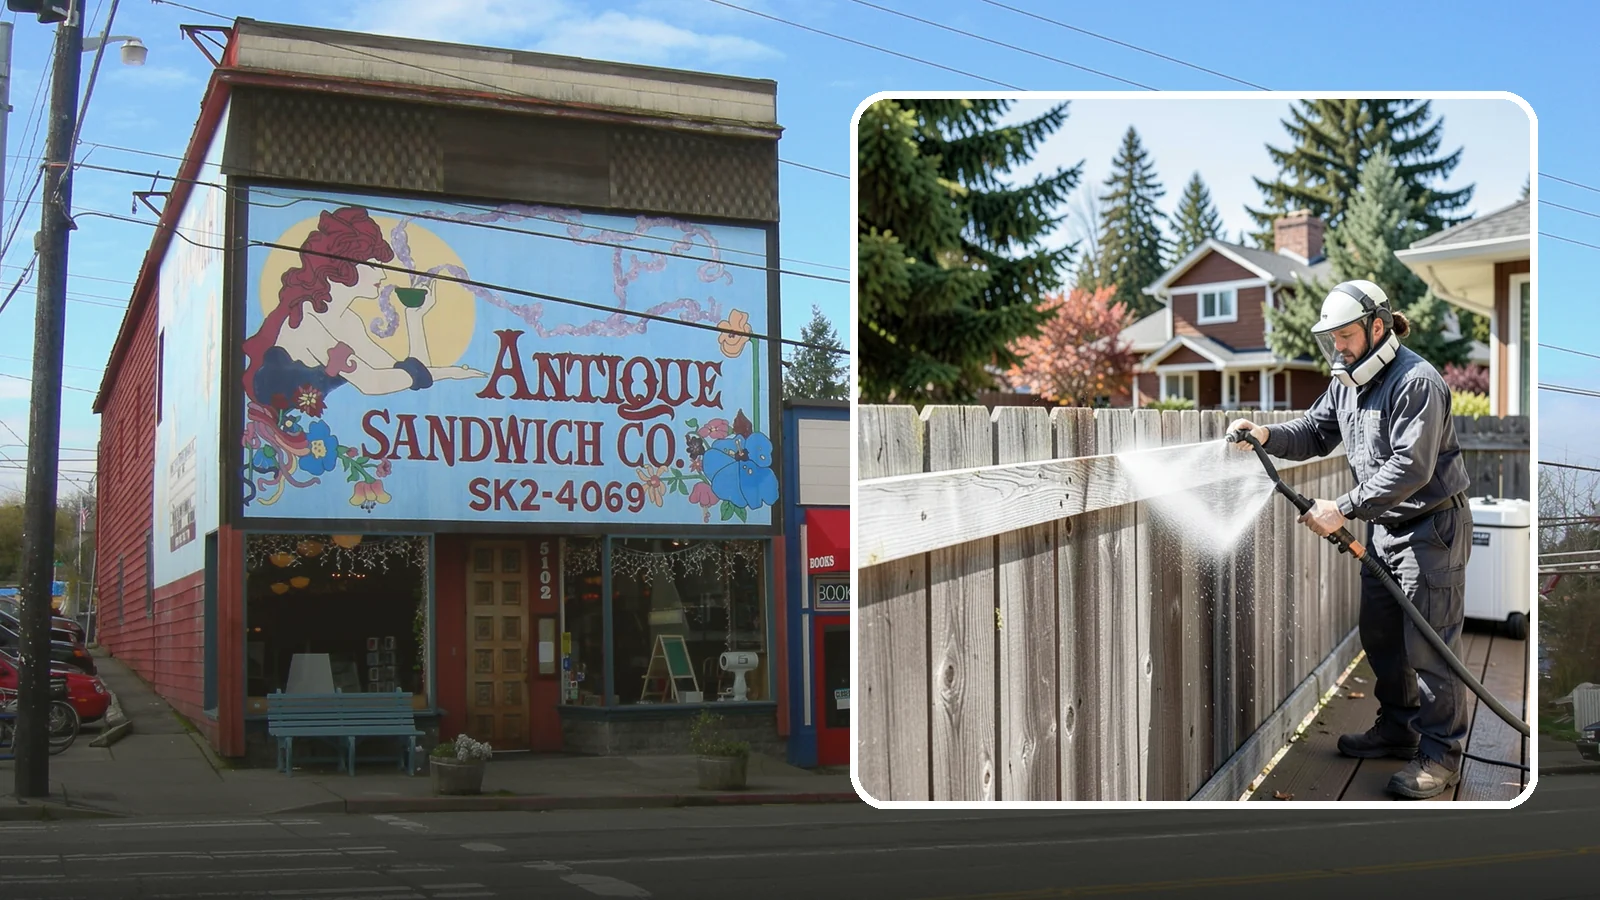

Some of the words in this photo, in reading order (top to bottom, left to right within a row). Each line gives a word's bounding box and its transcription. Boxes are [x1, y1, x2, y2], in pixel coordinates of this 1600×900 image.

[475, 329, 723, 420] ANTIQUE
[361, 408, 604, 467] SANDWICH
[617, 422, 684, 469] CO.
[468, 477, 645, 513] SK2-4069
[540, 542, 551, 599] 5102
[809, 555, 835, 569] BOOKS
